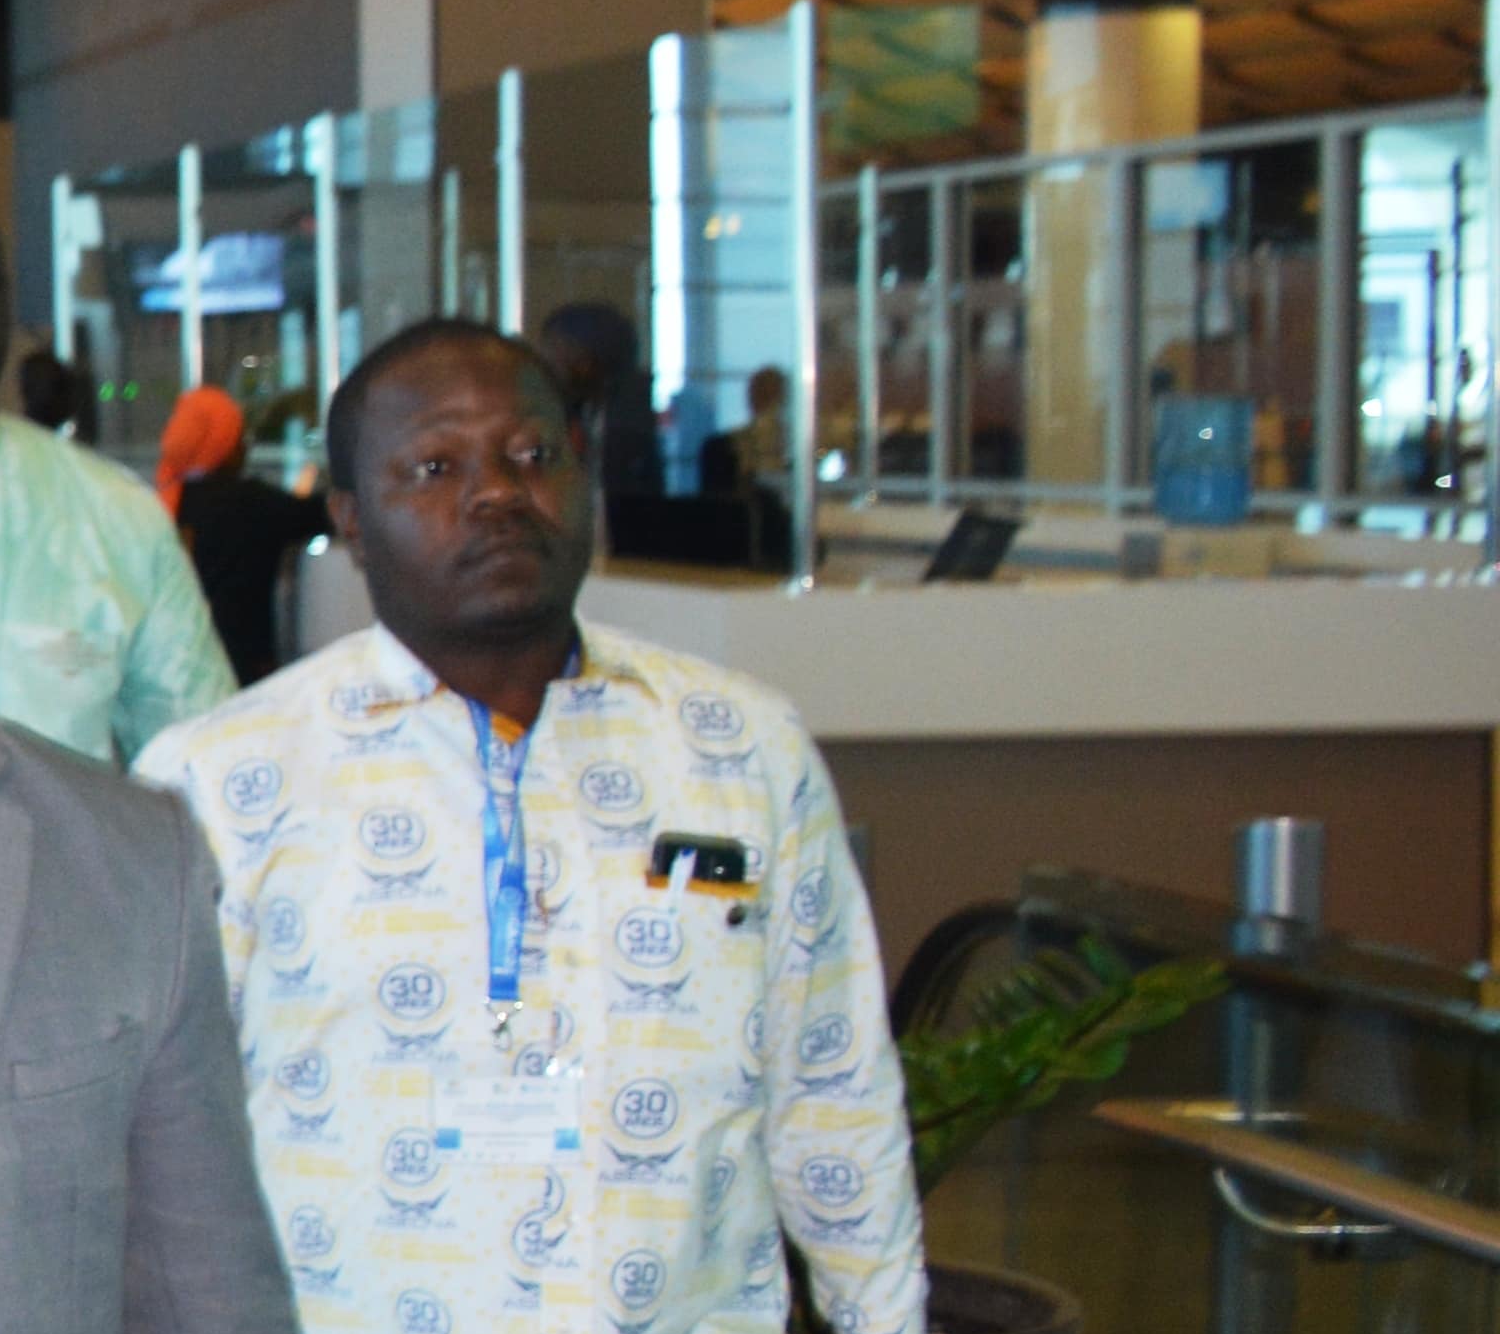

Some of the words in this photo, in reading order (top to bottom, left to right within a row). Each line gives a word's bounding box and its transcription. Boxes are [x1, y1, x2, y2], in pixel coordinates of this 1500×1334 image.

[368, 814, 414, 837] 30
[626, 918, 671, 943] 30
[388, 975, 433, 998] 30
[624, 1091, 668, 1114] 30
[392, 1139, 430, 1163] 30
[807, 1164, 852, 1188] 30
[621, 1261, 658, 1289] 30
